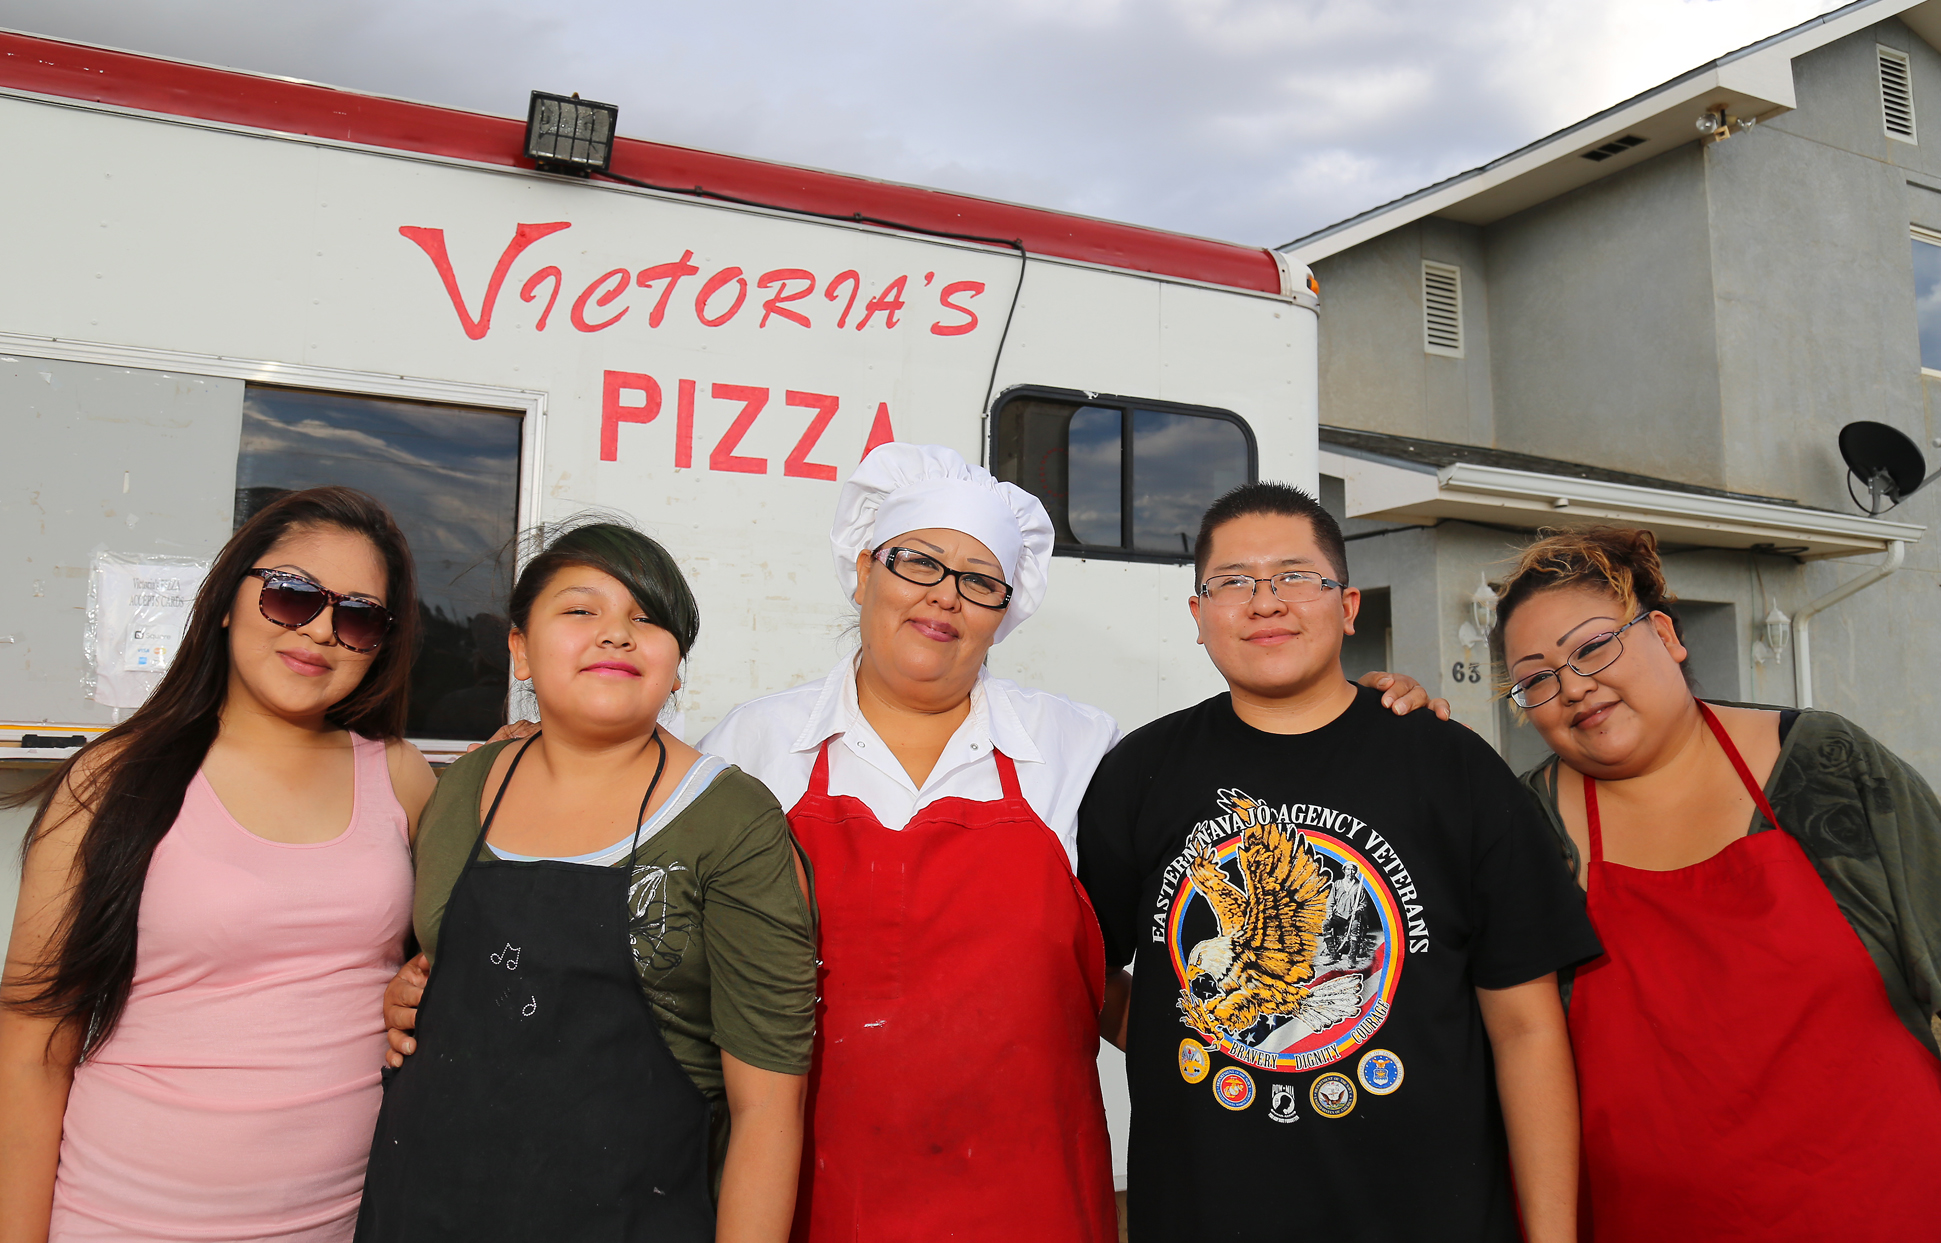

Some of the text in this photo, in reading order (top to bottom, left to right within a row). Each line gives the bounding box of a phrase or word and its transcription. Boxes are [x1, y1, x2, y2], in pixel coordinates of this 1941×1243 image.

[399, 221, 986, 340] VICTORIA'S
[129, 594, 185, 608] ACCEPTS CARDS
[1452, 661, 1481, 684] 63
[1152, 804, 1430, 954] EASTERN NAVAJO AGENCY VETERANS
[1229, 1040, 1279, 1069] BRAVERY
[1294, 1043, 1341, 1070] DIGNITY
[1350, 998, 1390, 1044] COURAGE
